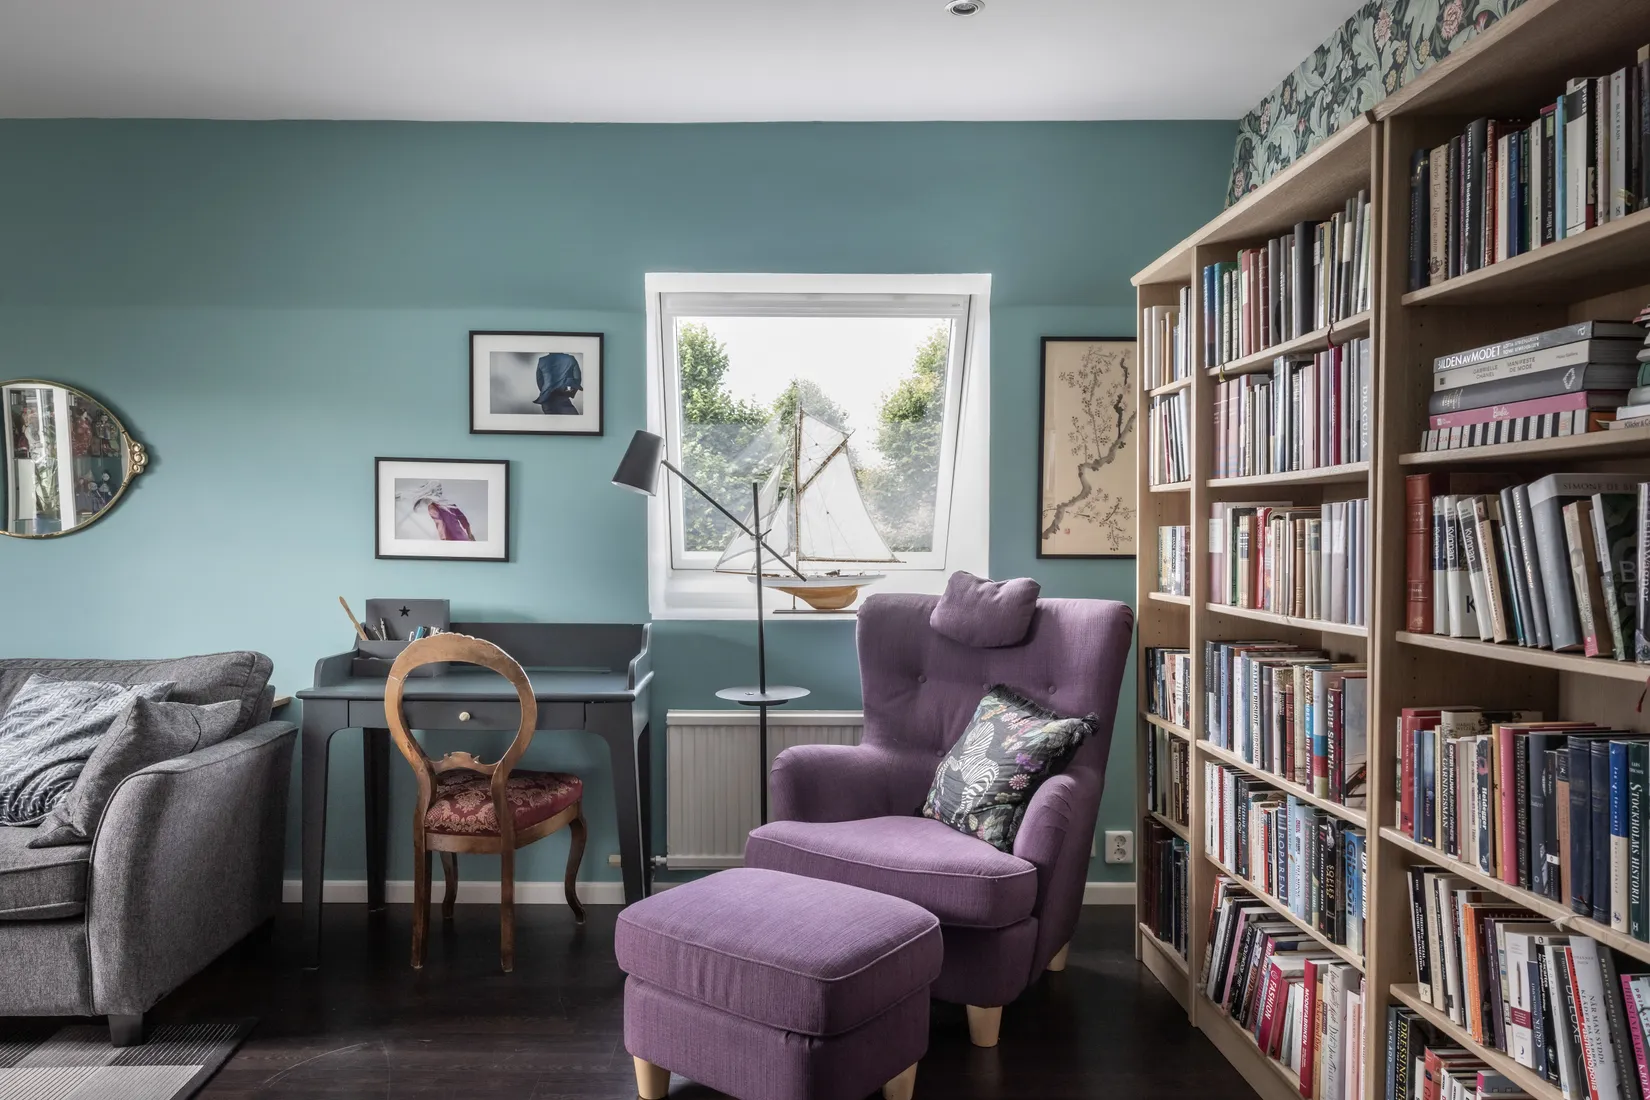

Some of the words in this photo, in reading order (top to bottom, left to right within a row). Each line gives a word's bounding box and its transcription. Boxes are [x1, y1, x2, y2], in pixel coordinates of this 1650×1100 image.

[1472, 346, 1501, 361] MODET
[1492, 406, 1510, 418] Barbie
[1563, 482, 1601, 490] SIMONE
[1464, 528, 1476, 562] Kvinnan
[1630, 782, 1643, 854] STOCKHOLMS
[1345, 840, 1356, 916] Gibson
[1631, 857, 1639, 904] HISTORIA
[1601, 958, 1610, 987] HENRIC
[1265, 978, 1277, 1020] FASHION
[1566, 984, 1581, 1044] DELUXE
[1589, 994, 1598, 1012] NÄR
[1301, 987, 1309, 1045] MODEFABRIKEN
[1592, 1014, 1601, 1034] MAN
[1534, 1018, 1543, 1048] GREEK
[1632, 1034, 1644, 1062] BARD
[1398, 1021, 1408, 1083] DRESSING
[1581, 1022, 1598, 1091] Fashionopolis
[1589, 1036, 1598, 1068] FABRIK
[1595, 1037, 1606, 1064] SYDDE
